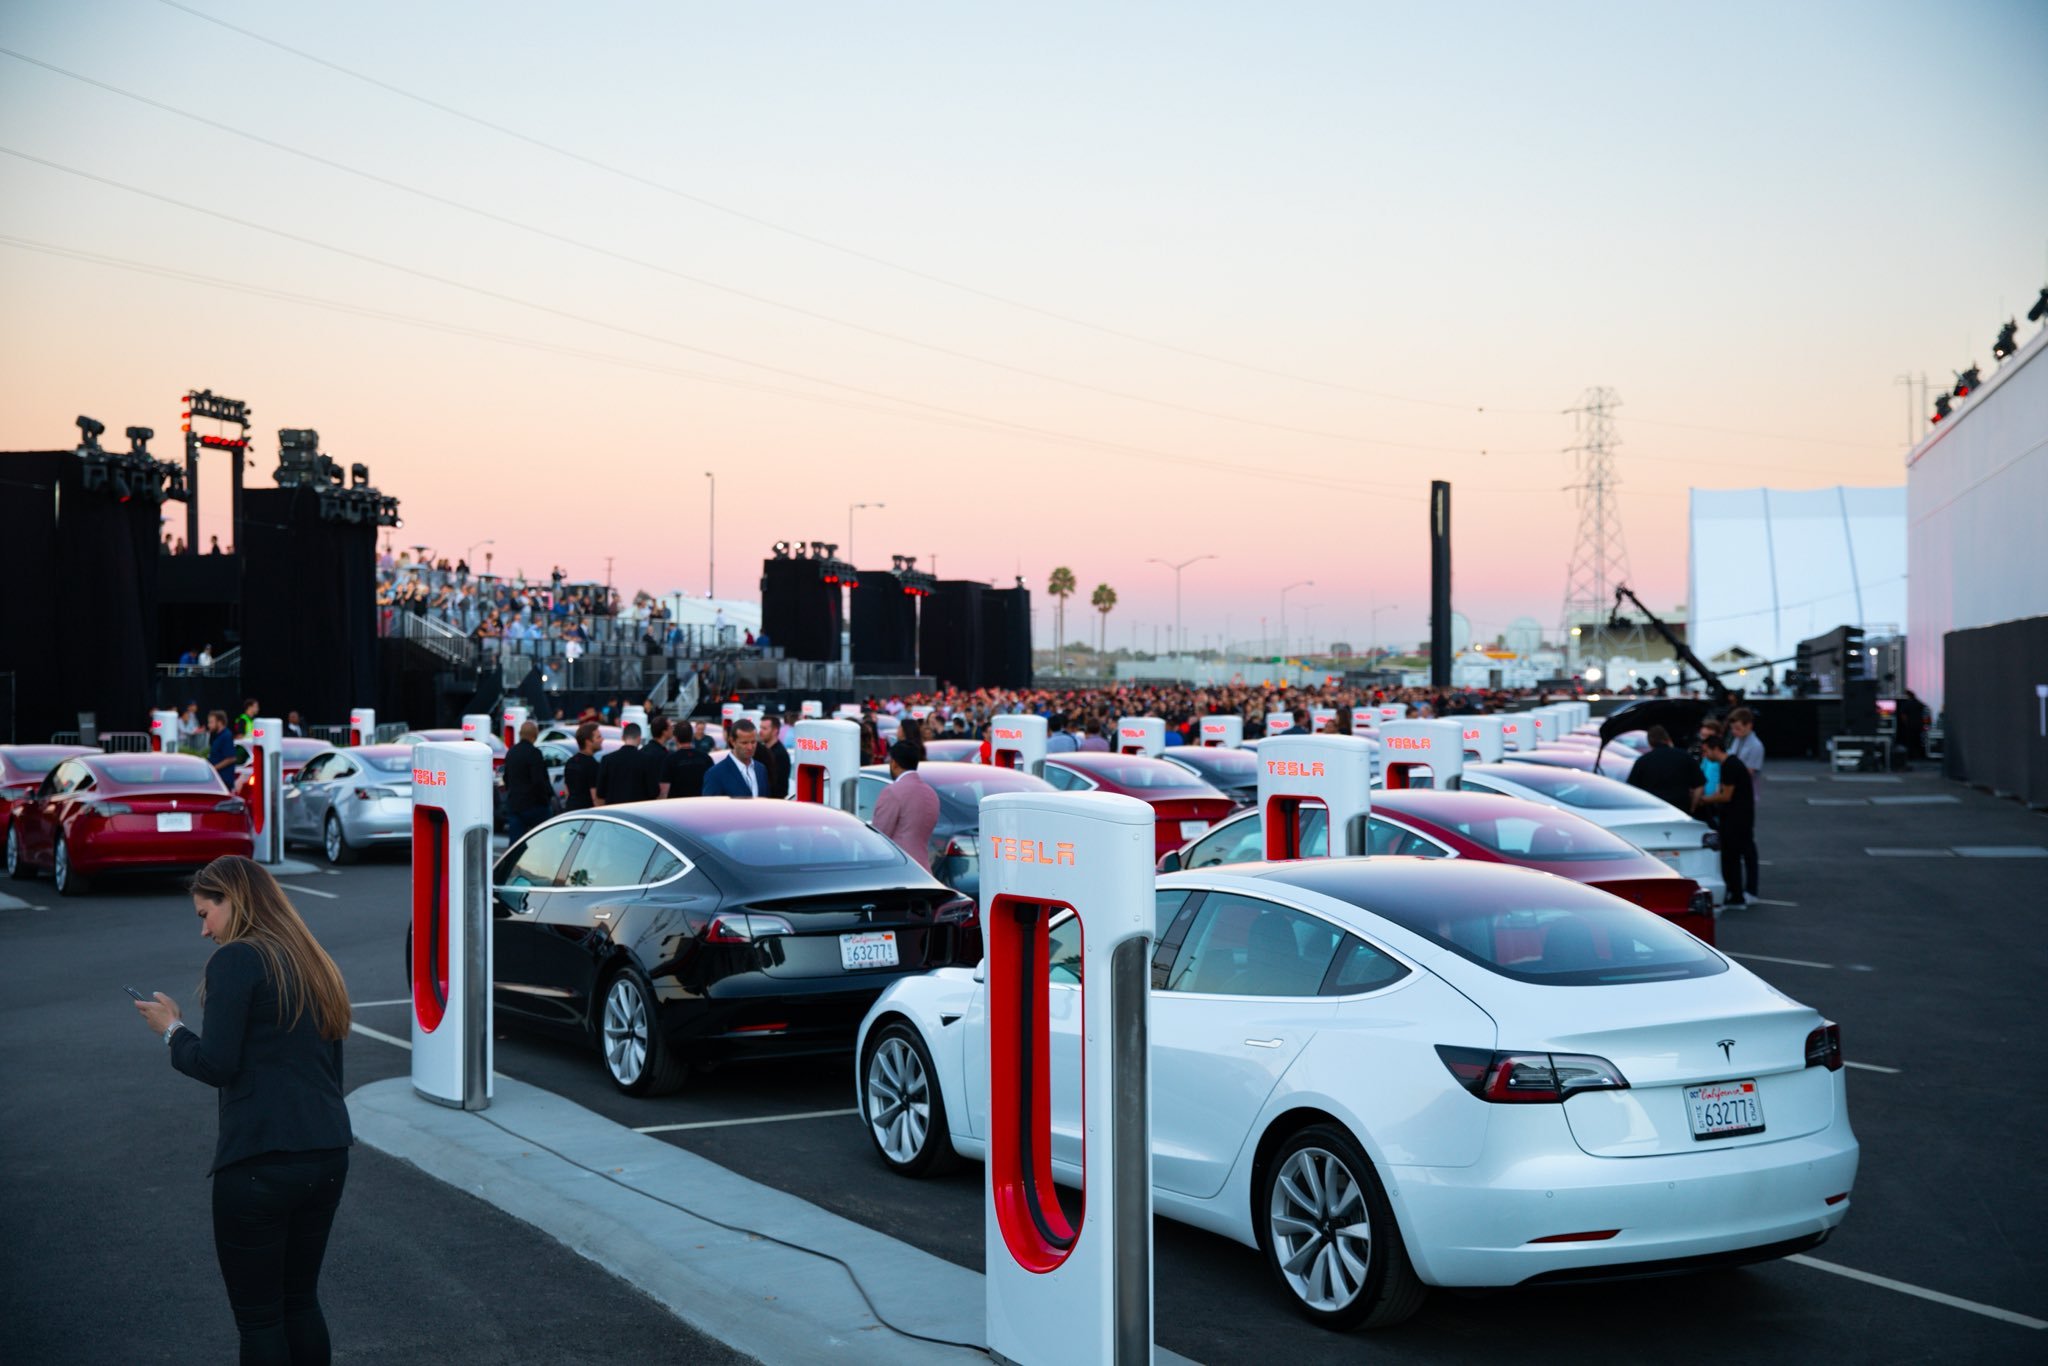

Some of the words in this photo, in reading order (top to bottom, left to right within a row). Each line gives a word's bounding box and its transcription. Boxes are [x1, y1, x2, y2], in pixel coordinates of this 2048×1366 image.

[1386, 737, 1431, 749] TESLA
[412, 768, 447, 786] TESLA
[1266, 761, 1325, 777] TESLA
[991, 835, 1075, 866] TESLA
[854, 945, 885, 961] 63277
[1701, 1087, 1743, 1100] California
[1705, 1099, 1748, 1127] 63277
